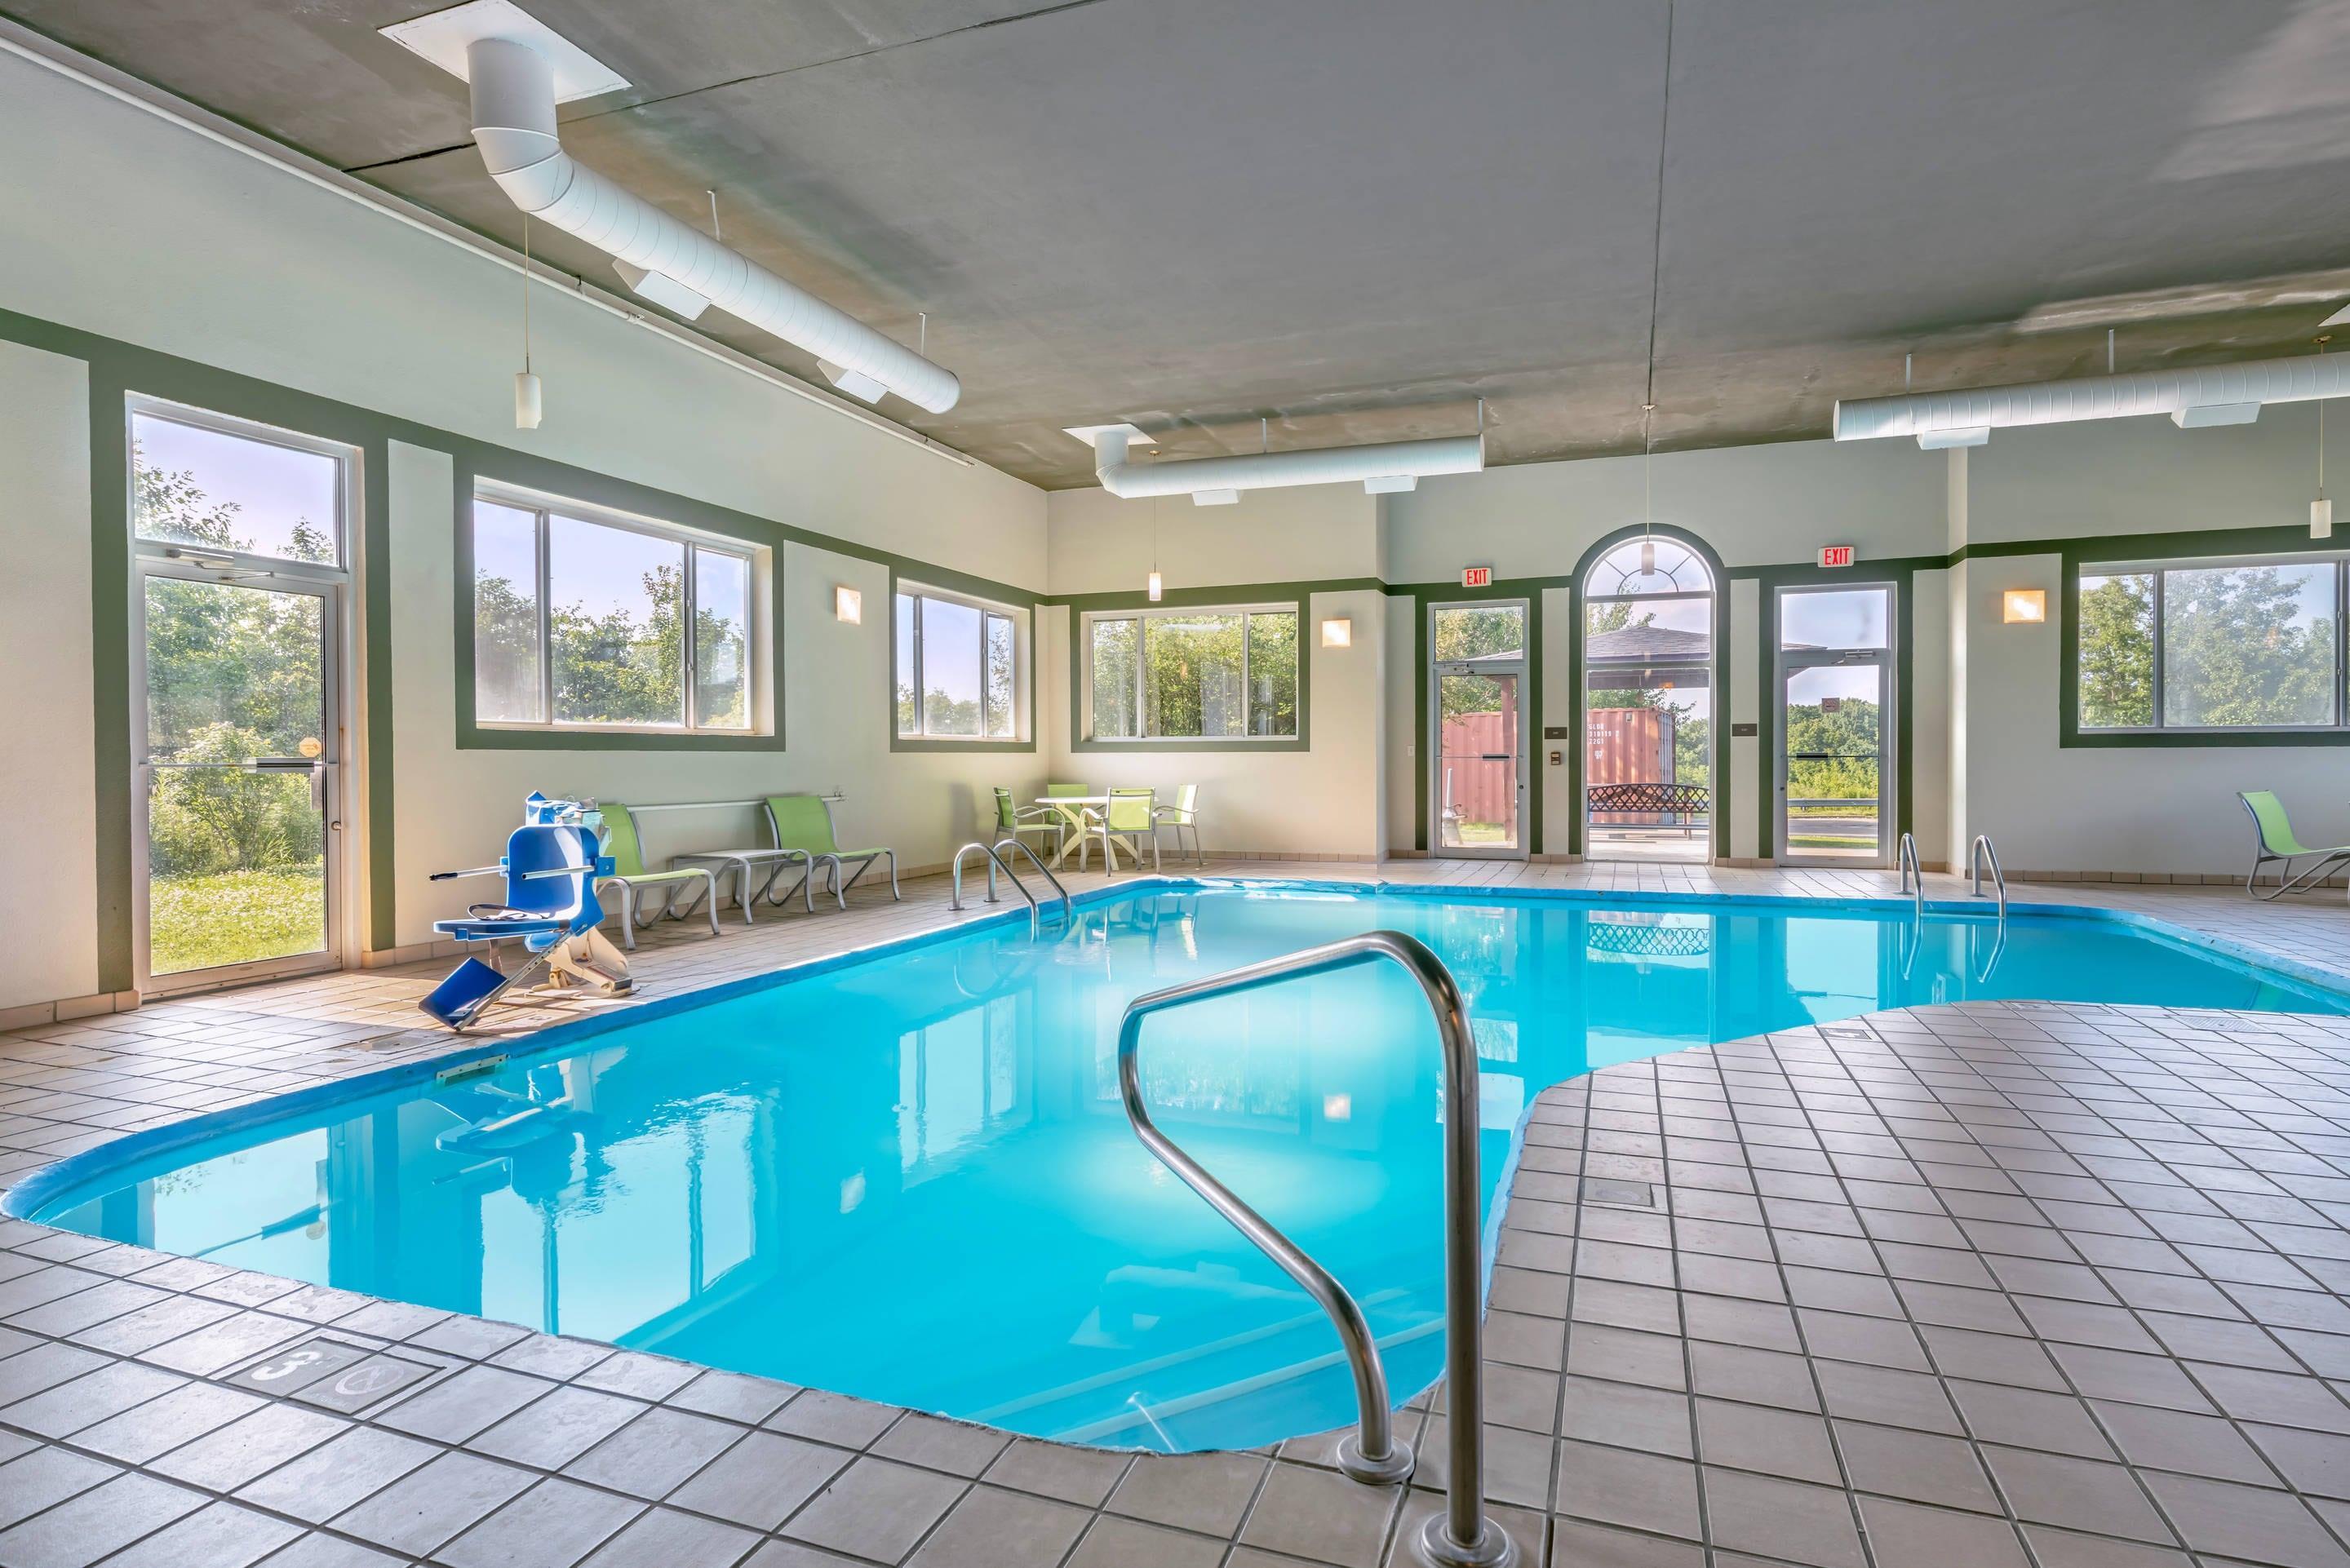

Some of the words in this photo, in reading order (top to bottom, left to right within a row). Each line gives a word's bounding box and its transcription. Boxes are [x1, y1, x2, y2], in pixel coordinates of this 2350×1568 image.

[1825, 547, 1850, 565] EXIT
[1467, 569, 1488, 585] EXIT
[251, 1351, 323, 1380] 3
